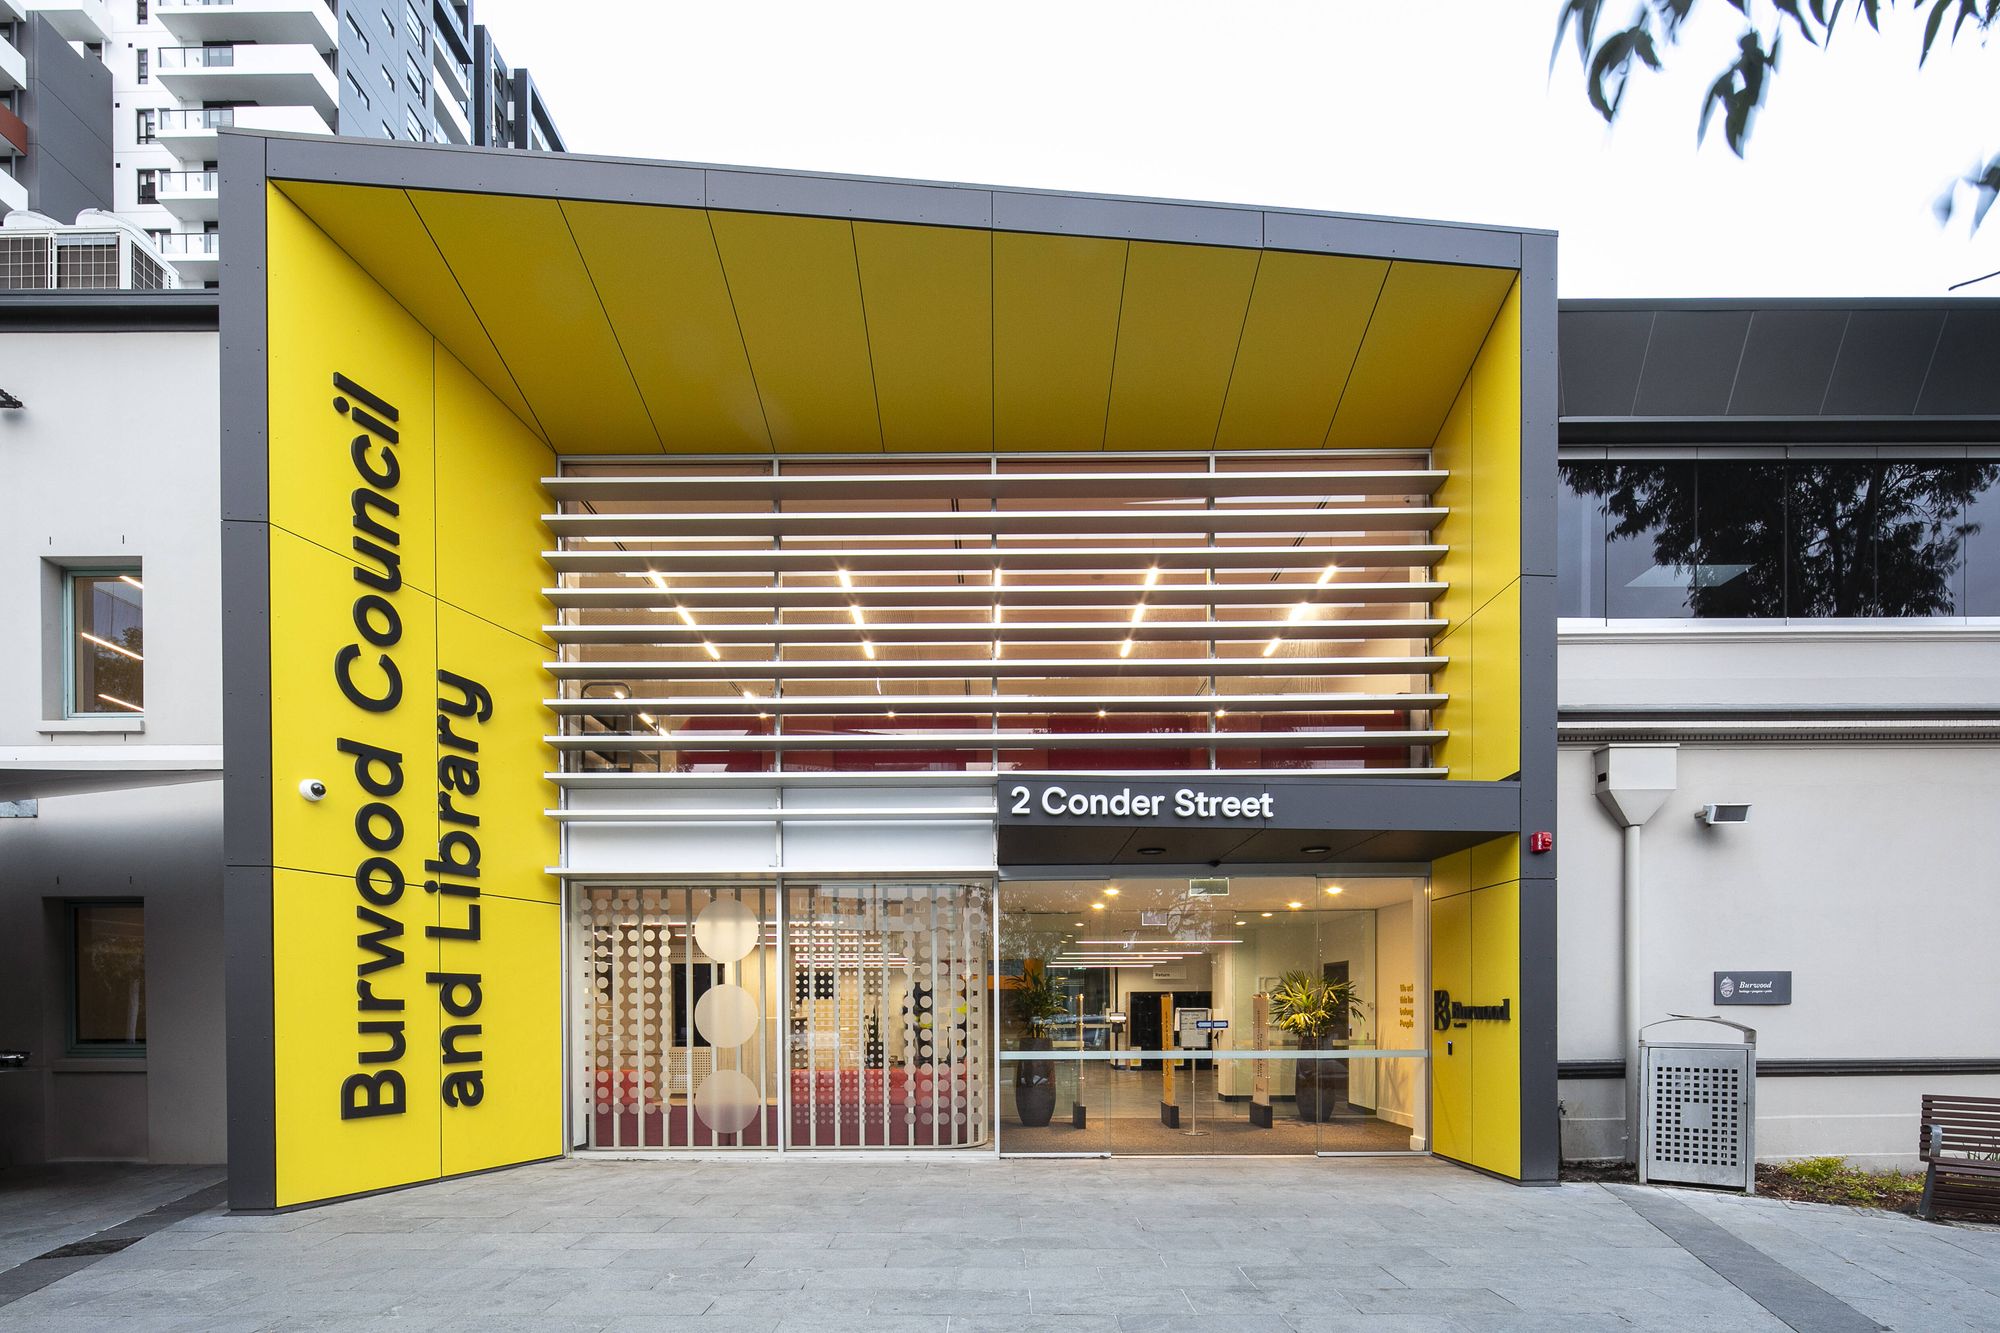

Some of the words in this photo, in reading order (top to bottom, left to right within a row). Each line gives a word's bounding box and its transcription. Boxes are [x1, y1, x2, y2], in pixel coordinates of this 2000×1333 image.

[333, 371, 403, 714] Council
[424, 669, 494, 944] Library
[1011, 785, 1031, 814] 2
[1041, 786, 1166, 816] Conder
[1174, 788, 1274, 818] Street
[337, 737, 407, 1121] Burwood
[1739, 981, 1772, 989] Burwood
[425, 972, 484, 1108] and
